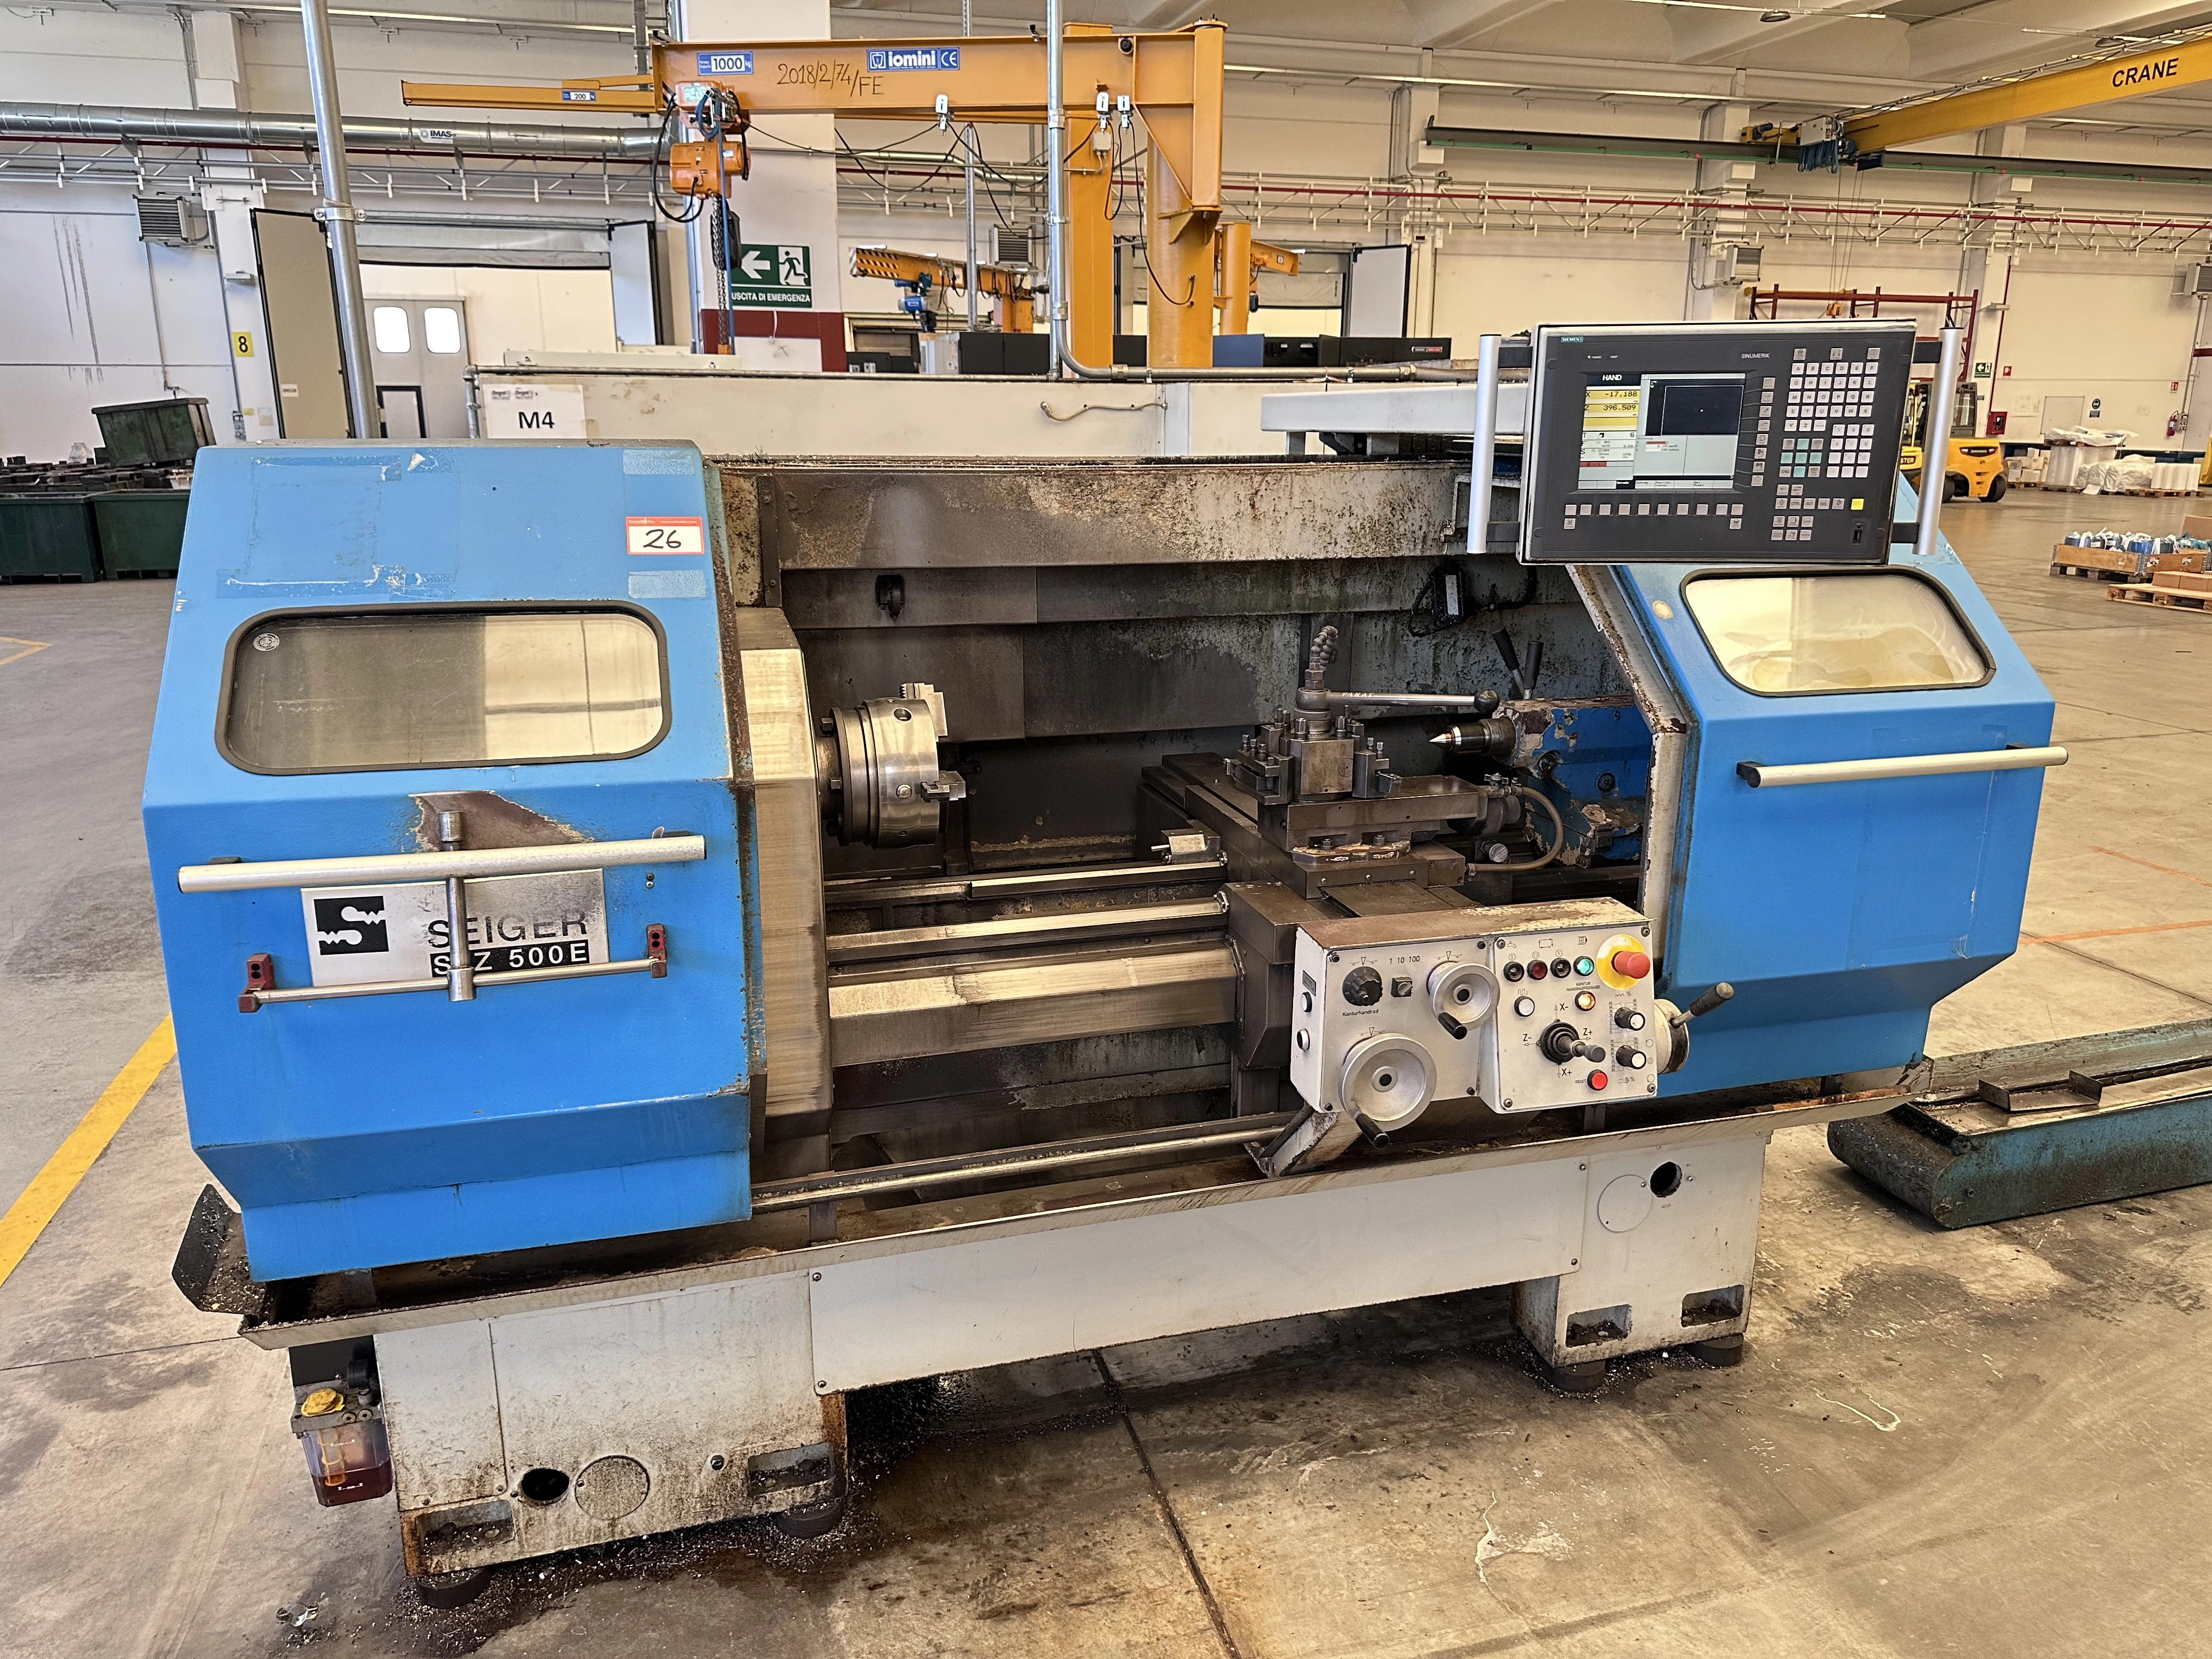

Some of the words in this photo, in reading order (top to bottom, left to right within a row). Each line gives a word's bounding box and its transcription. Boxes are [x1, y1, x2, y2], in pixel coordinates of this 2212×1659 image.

[713, 58, 742, 70] 1000
[2112, 58, 2179, 87] CRANE
[731, 292, 757, 301] USCITA
[768, 293, 810, 302] EMERGENZA
[238, 336, 249, 353] 8
[518, 411, 555, 428] M4
[643, 529, 681, 549] 26
[428, 911, 588, 949] SEIGER
[434, 951, 493, 975] SZ
[509, 943, 587, 968] 500E
[1342, 1008, 1379, 1017] Konturhandrad
[1560, 1002, 1568, 1011] X-
[1583, 1028, 1593, 1036] Z+
